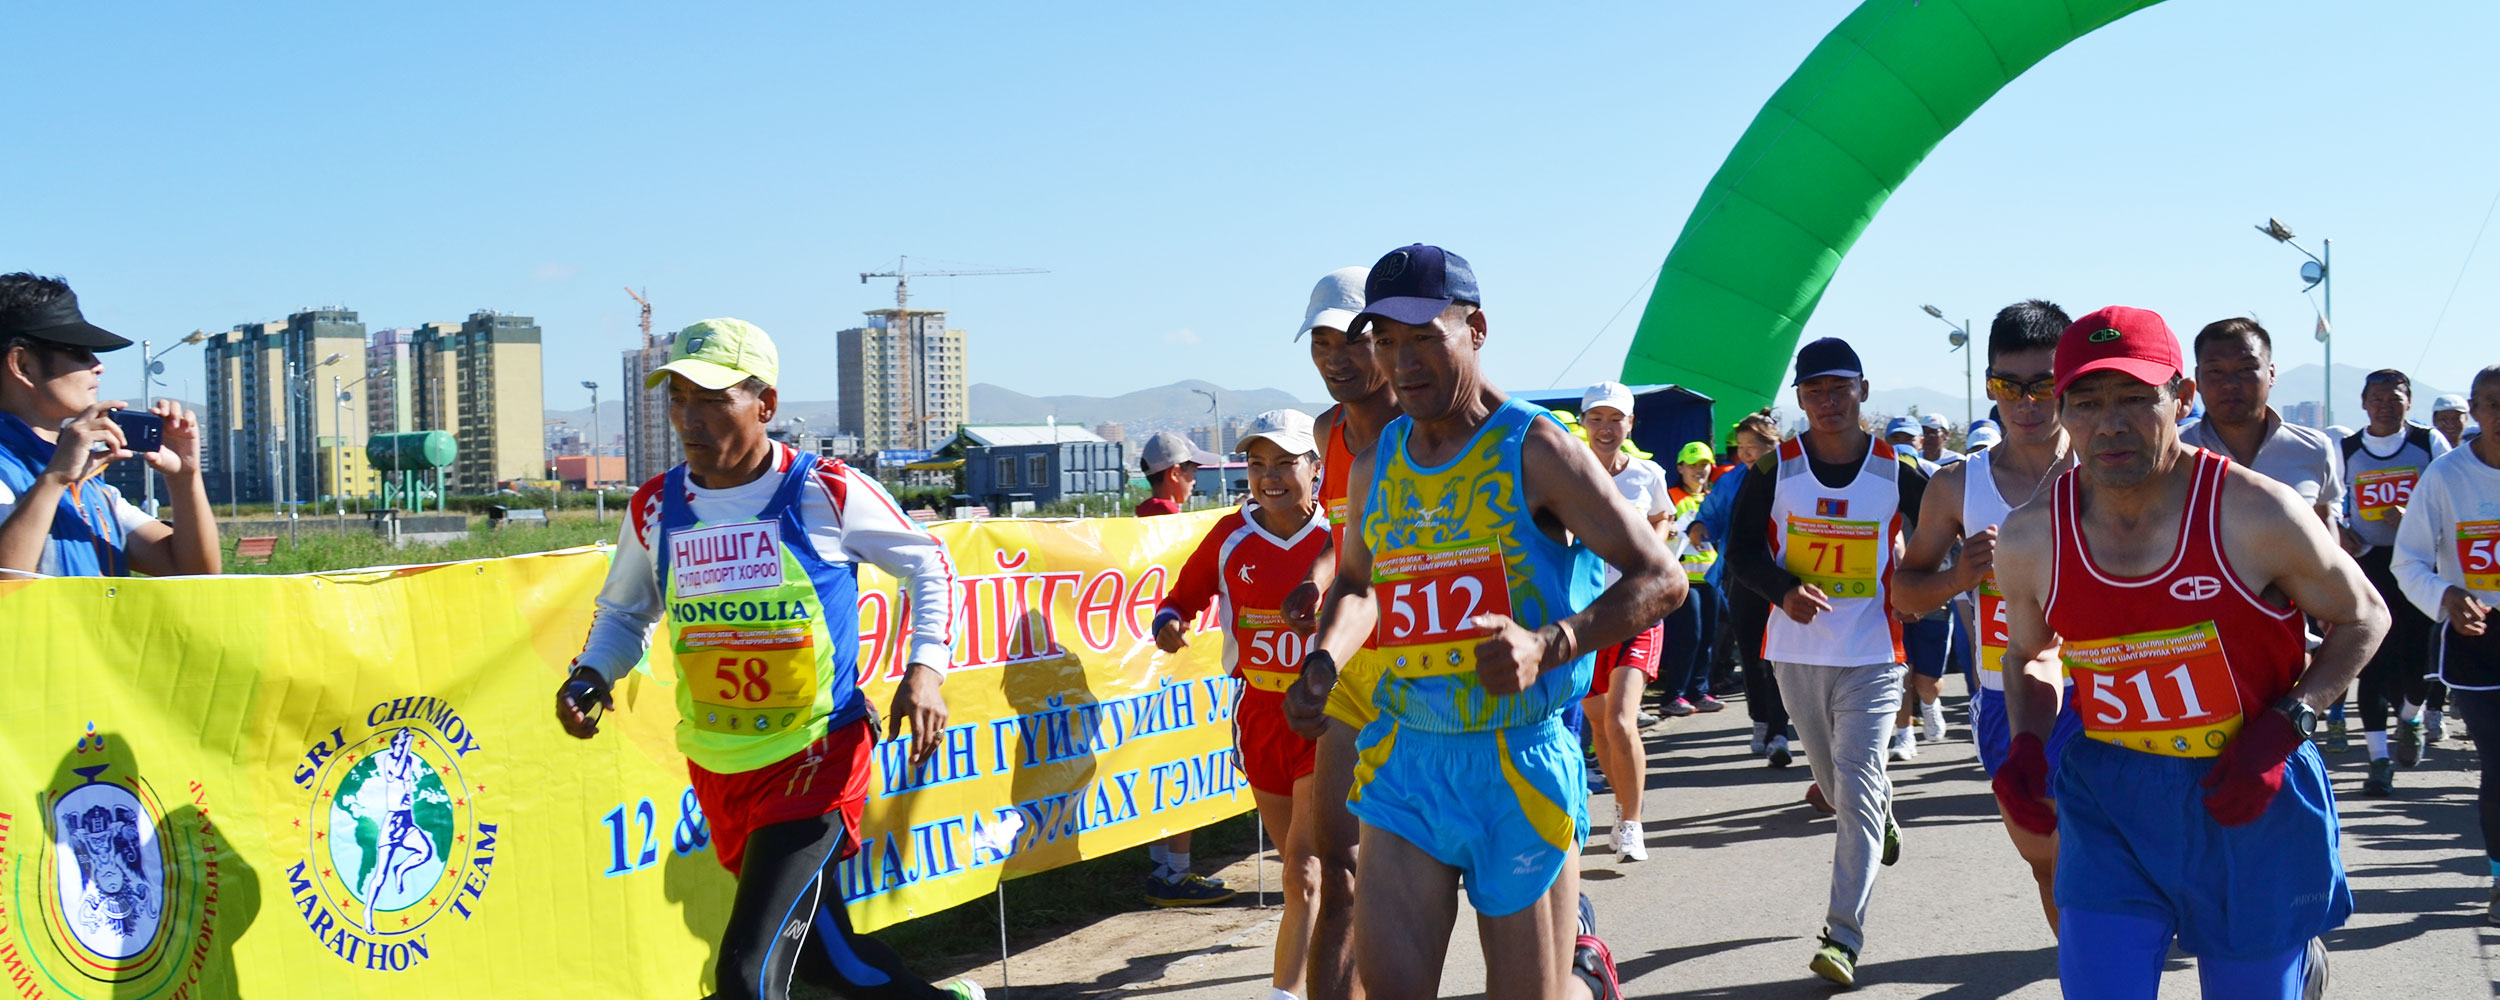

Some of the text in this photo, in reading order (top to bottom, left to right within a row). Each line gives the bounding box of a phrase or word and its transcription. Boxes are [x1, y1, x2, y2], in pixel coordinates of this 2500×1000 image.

[675, 531, 776, 569] НШШГА
[702, 566, 735, 584] СПОРТ
[738, 562, 778, 581] ХОРОО
[1808, 541, 1846, 574] 71
[670, 600, 810, 623] MONGOLIA
[1391, 575, 1483, 638] 512
[715, 657, 771, 703] 58
[2092, 663, 2212, 725] 511
[293, 694, 482, 791] SRI CHINMOY
[602, 798, 659, 877] 12
[672, 785, 711, 857] &
[285, 820, 498, 972] MARATHON TEAM
